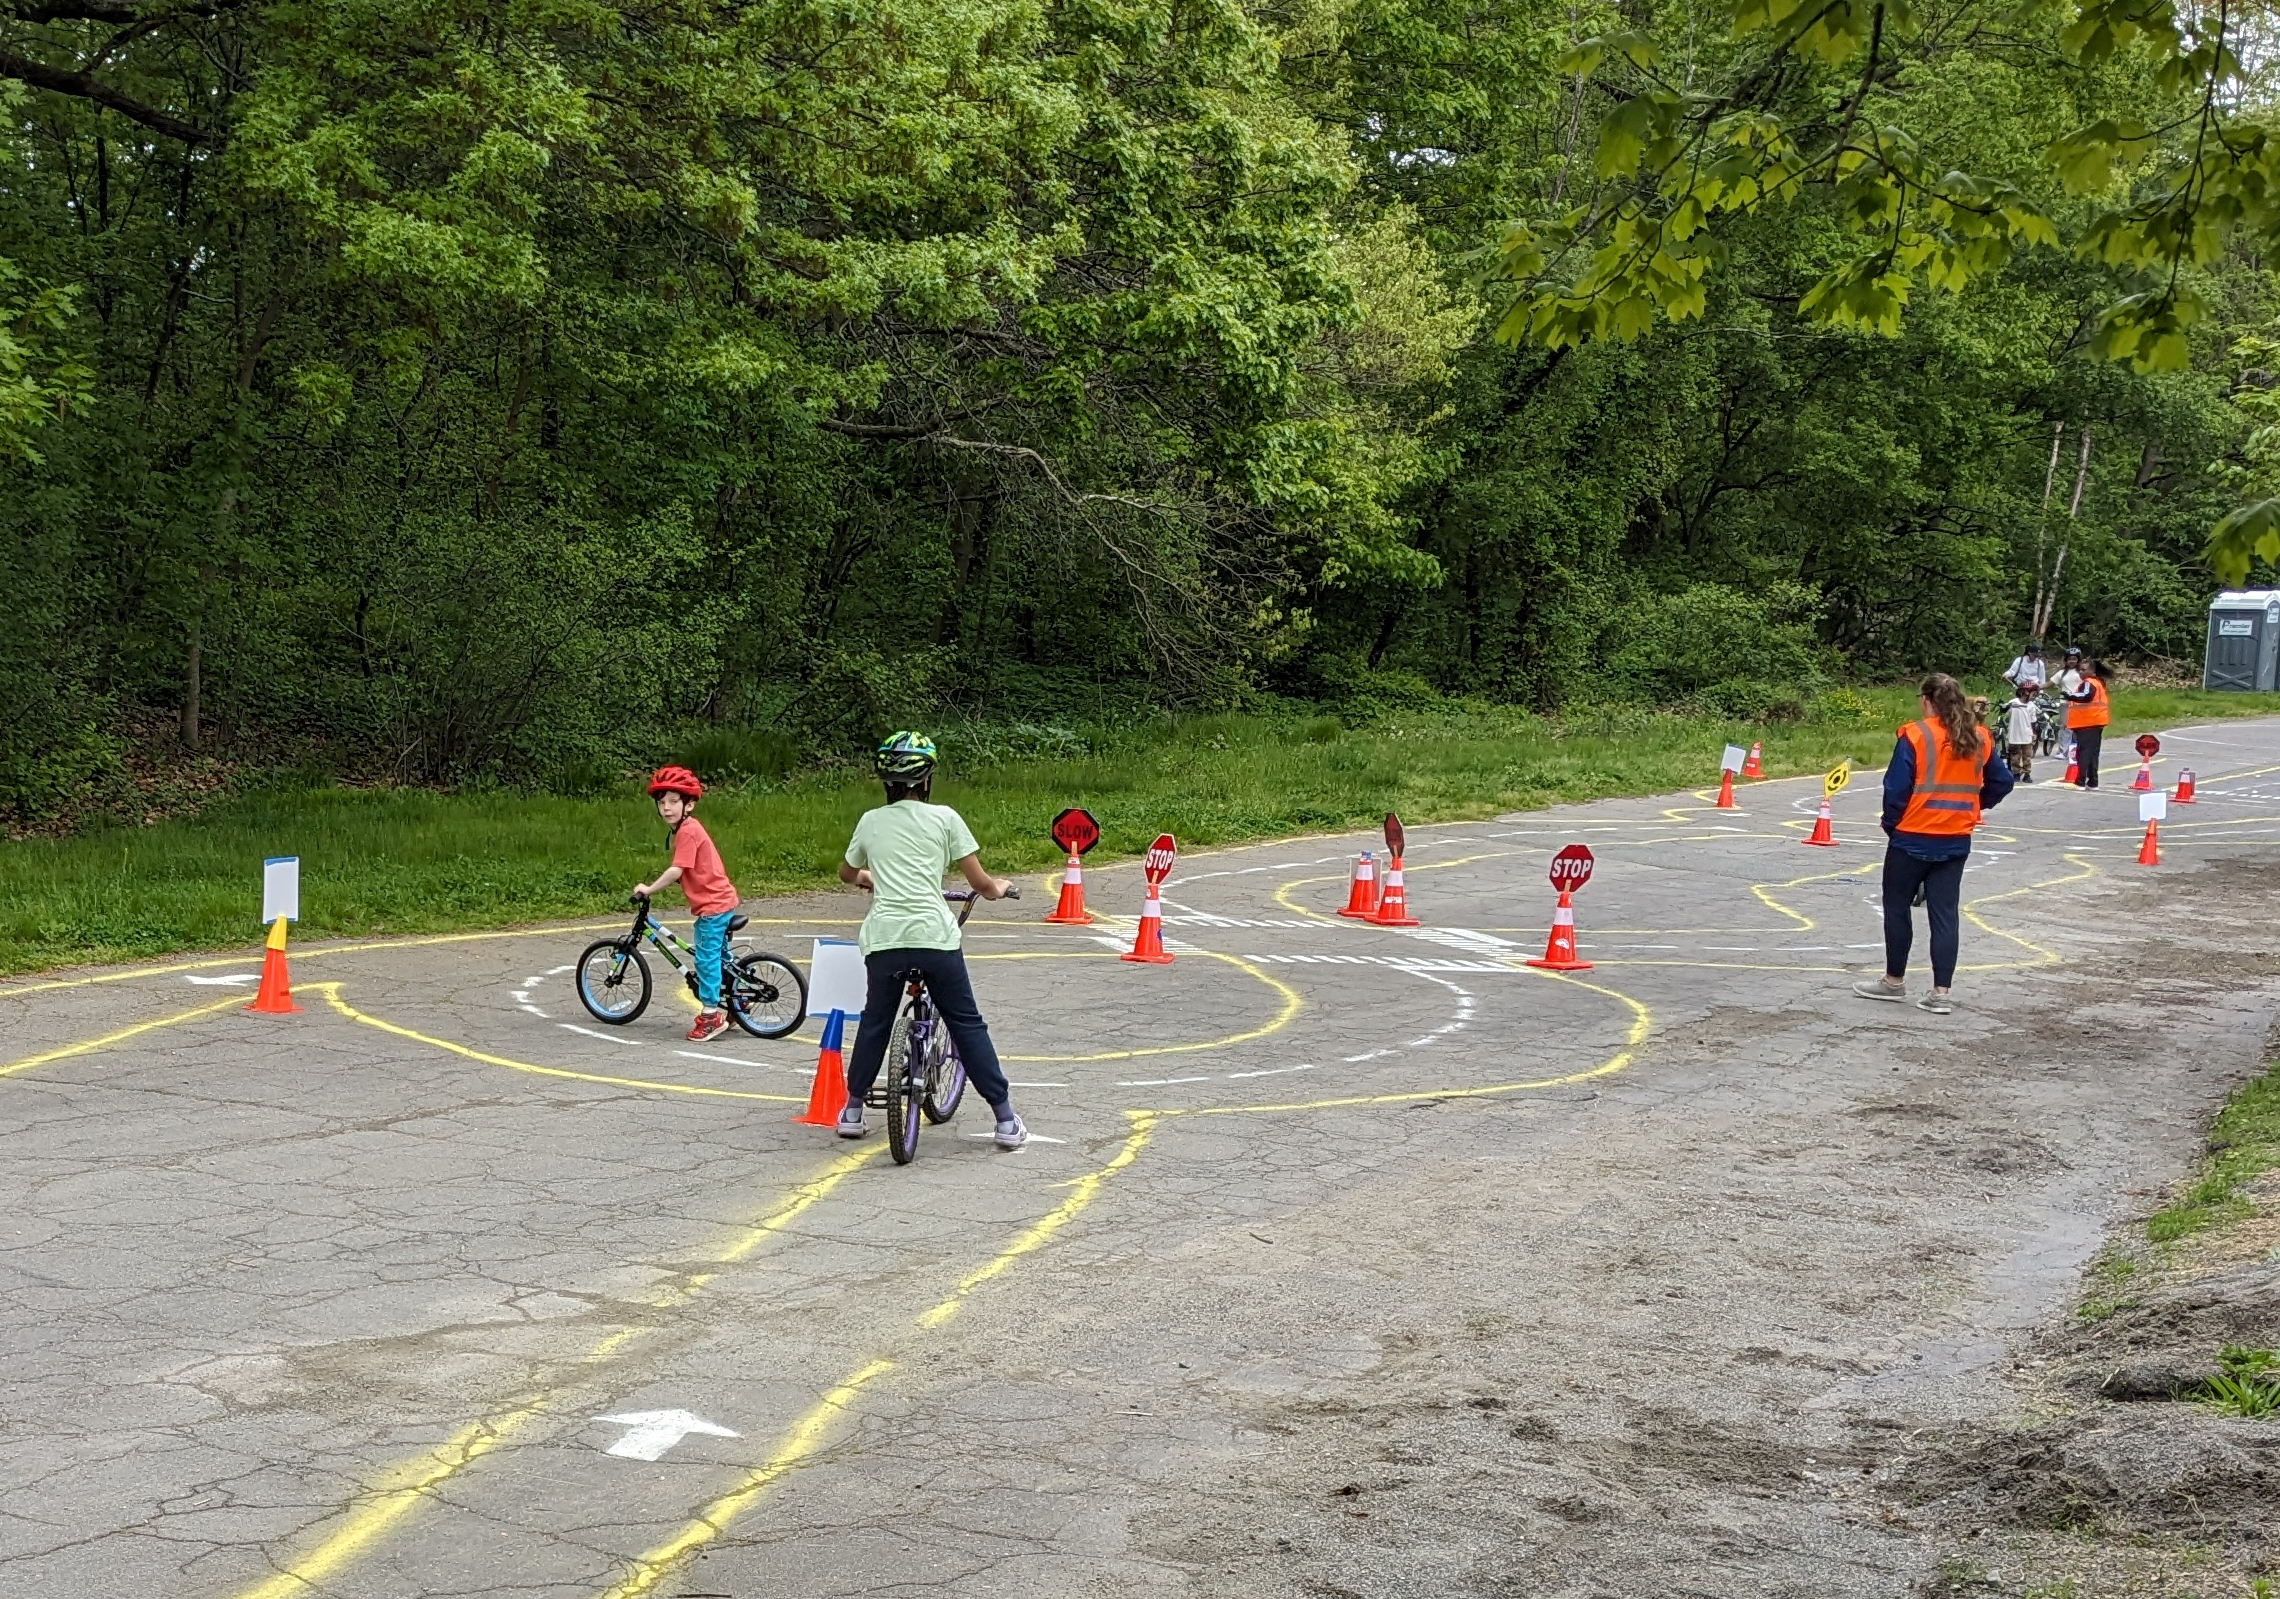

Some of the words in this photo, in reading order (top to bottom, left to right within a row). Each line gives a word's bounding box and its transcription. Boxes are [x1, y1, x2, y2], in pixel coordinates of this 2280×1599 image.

[1057, 823, 1093, 839] SLOW
[1146, 848, 1174, 870] STOP
[1551, 858, 1592, 878] STOP
